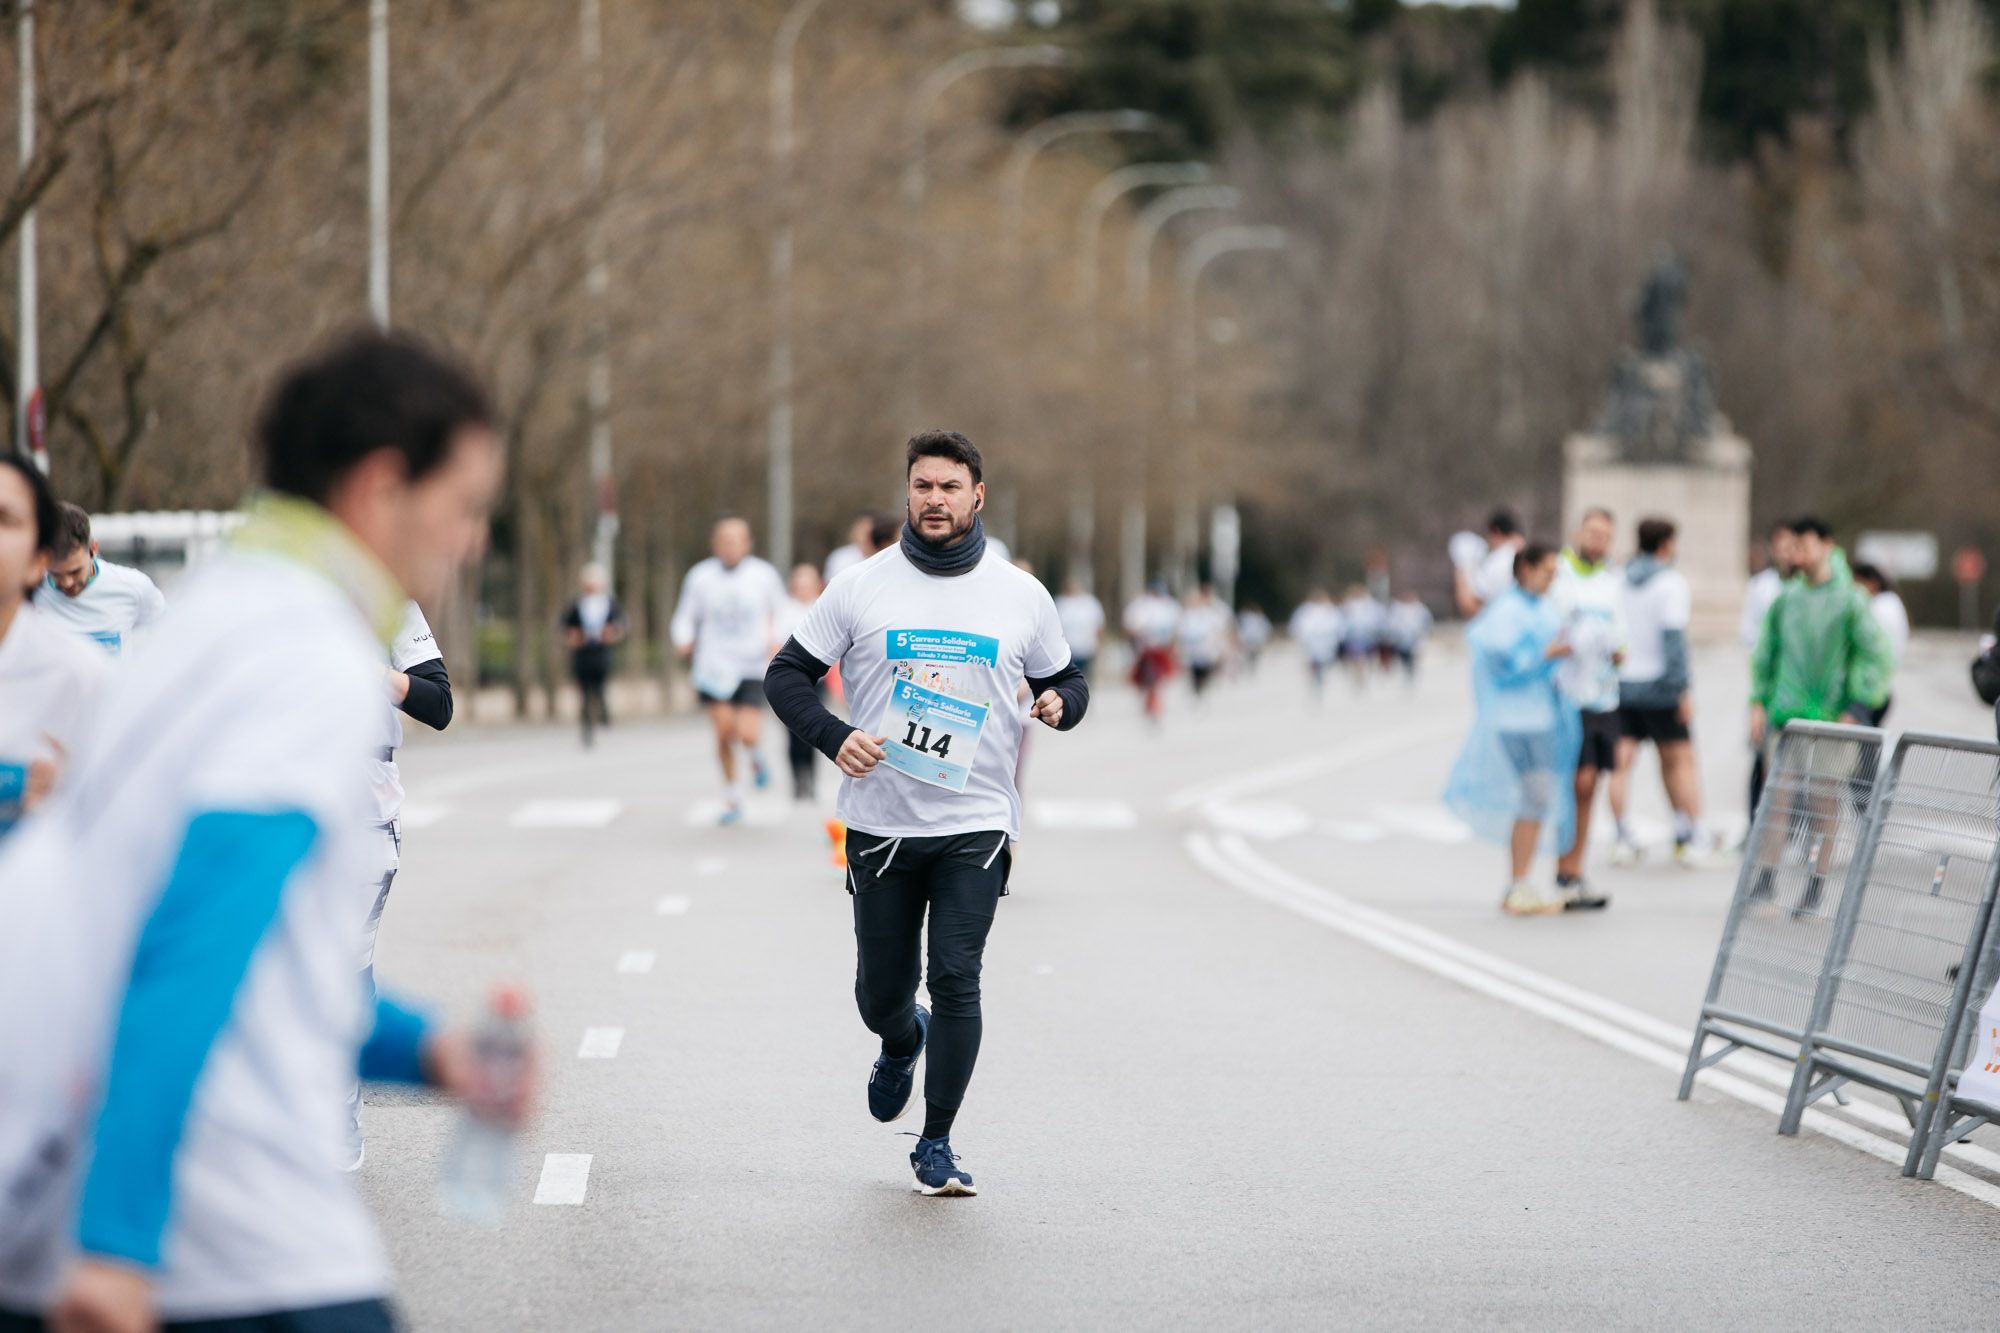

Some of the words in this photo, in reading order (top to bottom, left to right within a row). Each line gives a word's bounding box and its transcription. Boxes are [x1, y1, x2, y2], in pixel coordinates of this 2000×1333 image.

[910, 635, 940, 644] Carrera
[942, 637, 977, 647] Solidaria
[965, 654, 992, 668] 2026
[912, 692, 939, 708] Carrera
[940, 702, 972, 718] Solidaria
[901, 721, 952, 759] 114
